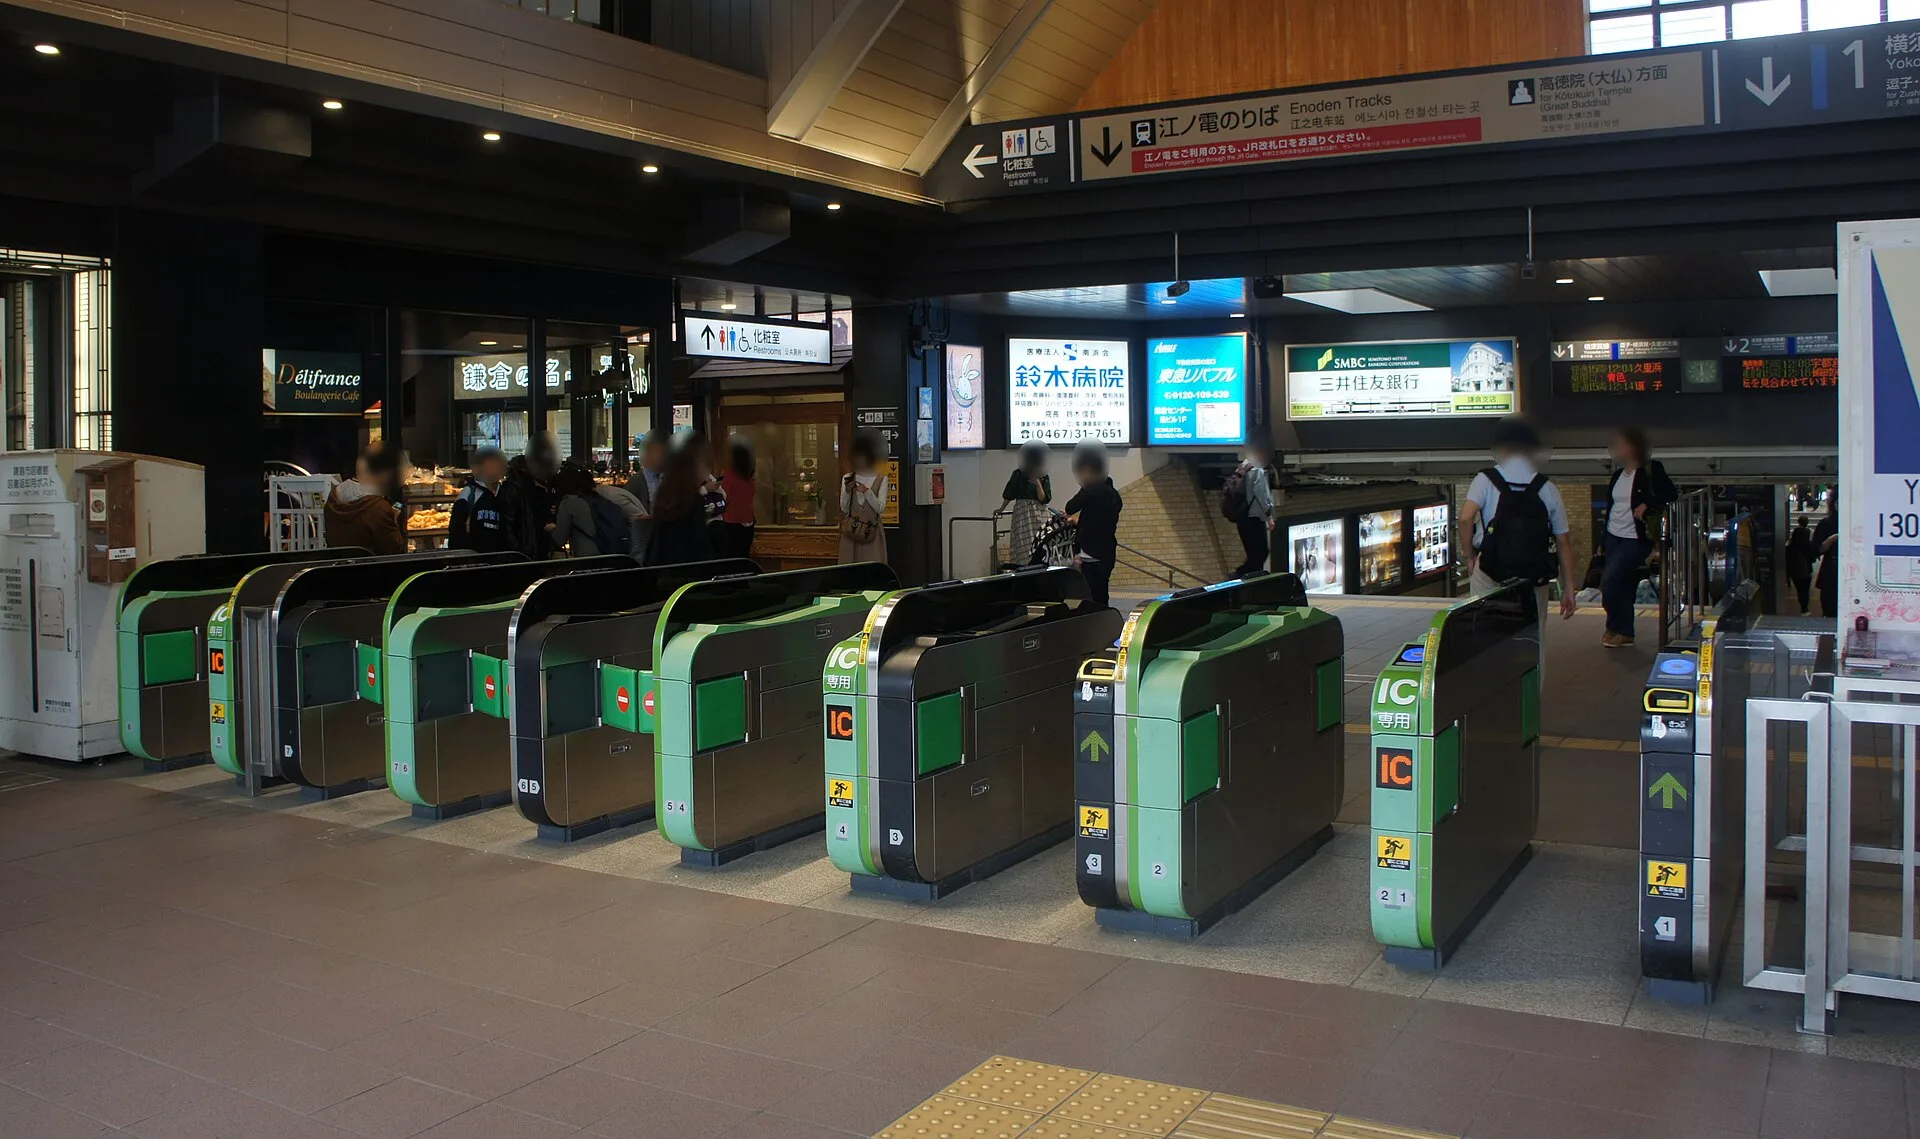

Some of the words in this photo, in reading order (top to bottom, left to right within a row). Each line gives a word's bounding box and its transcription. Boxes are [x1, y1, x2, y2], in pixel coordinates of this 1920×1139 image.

[1842, 39, 1865, 89] 1
[1540, 92, 1553, 103] for
[1597, 86, 1633, 98] Temple
[1886, 91, 1897, 99] for
[1289, 98, 1342, 115] Enoden
[1345, 93, 1392, 109] Tracks
[1540, 102, 1569, 113] (Great
[1572, 98, 1611, 110] Buddha)
[1158, 103, 1281, 139] 江ノ電のりば
[1289, 114, 1345, 131] 江之电车站
[1003, 157, 1034, 172] 化粧室
[1227, 154, 1236, 162] the
[1236, 153, 1244, 161] JR
[1003, 171, 1037, 180] Restrooms
[753, 328, 781, 345] 化粧室
[753, 345, 782, 356] Restrooms
[1027, 348, 1060, 356] 医療法人
[1567, 344, 1574, 358] 1
[1739, 338, 1750, 353] 2
[1334, 357, 1366, 369] SMBC
[1634, 362, 1663, 374] 久里浜
[276, 363, 361, 389] Délifrance
[462, 358, 571, 391] 鎌倉の名
[1016, 364, 1125, 388] 鈴木病院
[1319, 373, 1420, 393] 三井住友銀行
[294, 389, 341, 403] Boulangerie
[1031, 429, 1122, 439] (0467)31-7651
[1904, 479, 1920, 505] Y
[210, 605, 229, 623] IC
[211, 652, 224, 672] IC
[829, 646, 859, 670] IC
[827, 674, 851, 690] 専用
[1377, 678, 1419, 706] IC
[830, 709, 853, 738] IC
[1377, 711, 1411, 730] 専用
[394, 763, 399, 771] 7
[403, 764, 408, 772] 6
[1381, 754, 1412, 786] IC
[521, 782, 527, 790] 6
[531, 783, 537, 791] 5
[667, 801, 673, 811] 5
[679, 803, 685, 812] 4
[839, 825, 846, 835] 4
[892, 832, 899, 842] 3
[1091, 857, 1098, 867] 3
[1154, 864, 1162, 875] 2
[1381, 890, 1389, 901] 2
[1400, 892, 1406, 903] 1
[1663, 920, 1669, 932] 1
